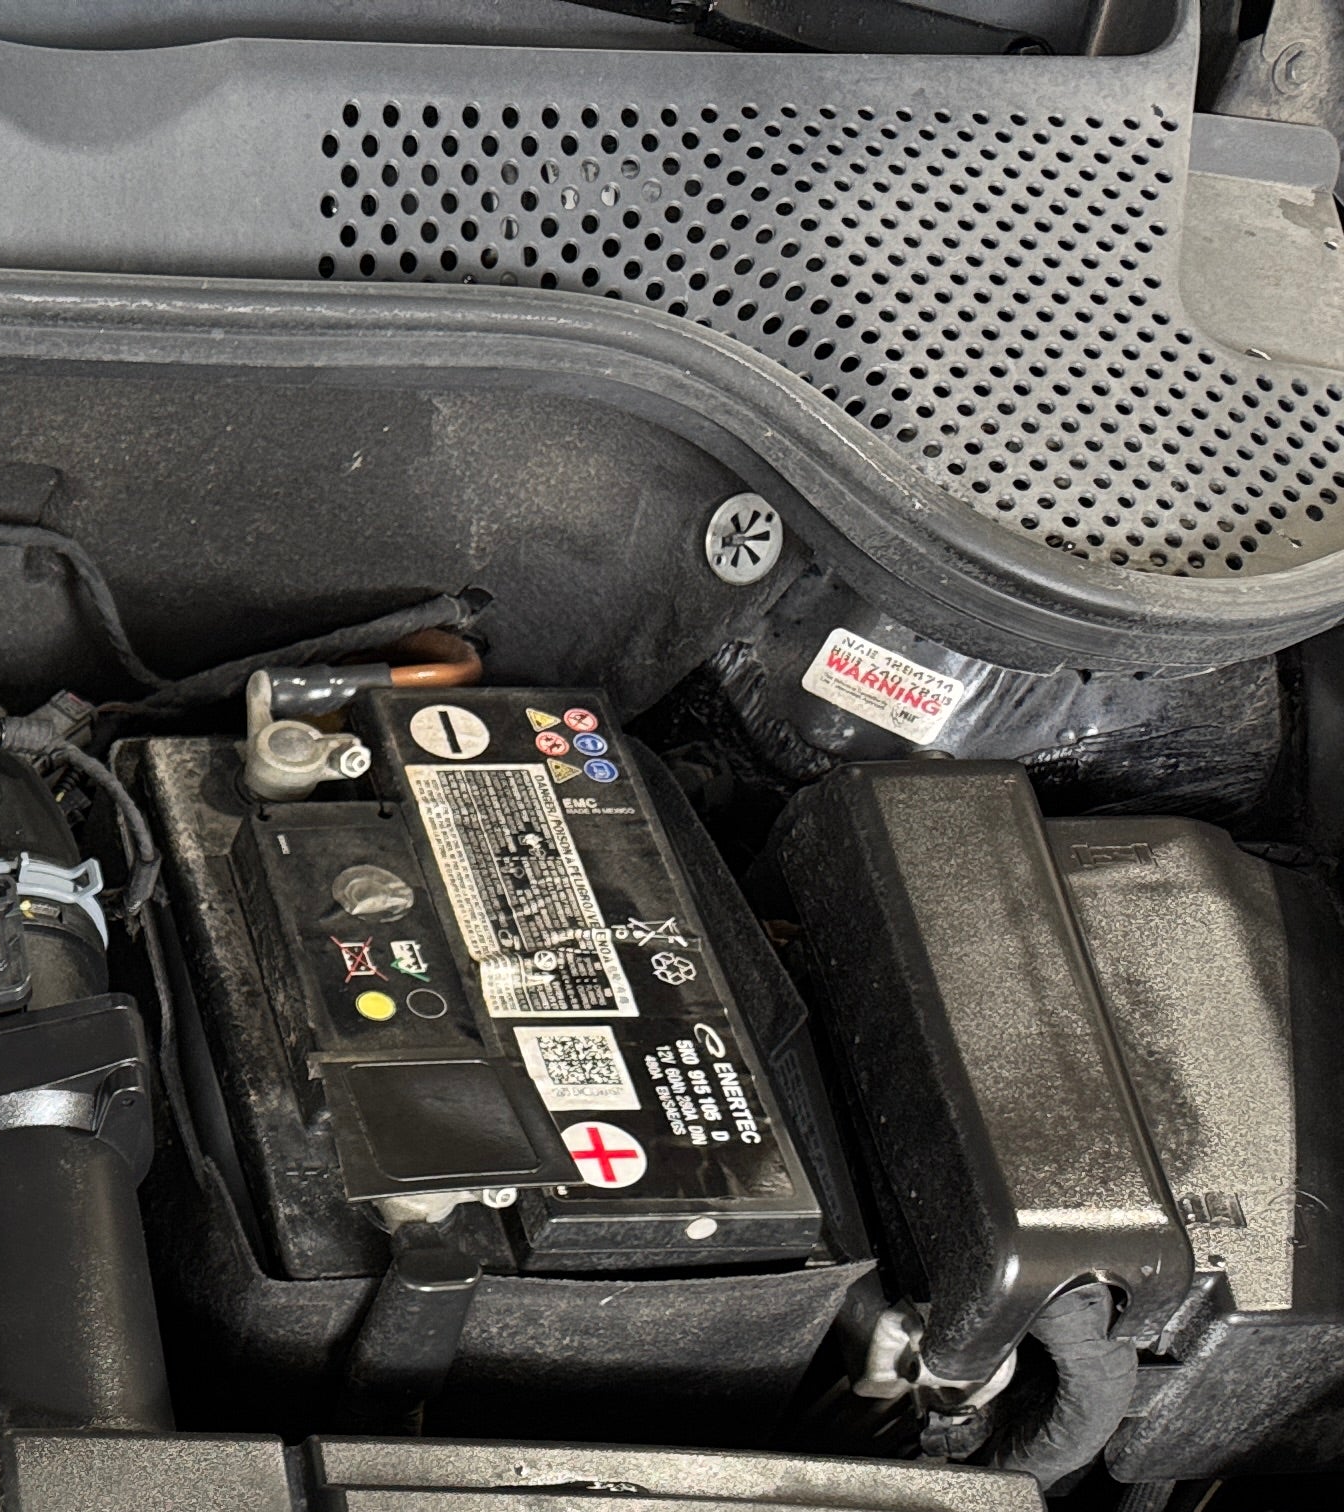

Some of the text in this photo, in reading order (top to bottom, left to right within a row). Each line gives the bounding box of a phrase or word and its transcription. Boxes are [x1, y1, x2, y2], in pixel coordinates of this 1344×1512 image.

[826, 651, 940, 716] WARNING
[562, 797, 597, 808] EMC
[688, 1070, 712, 1094] 915
[656, 1045, 708, 1145] 12V 60Ah DIN
[713, 1062, 761, 1144] ENERTEC
[698, 1096, 722, 1121] 105
[711, 1130, 730, 1141] D
